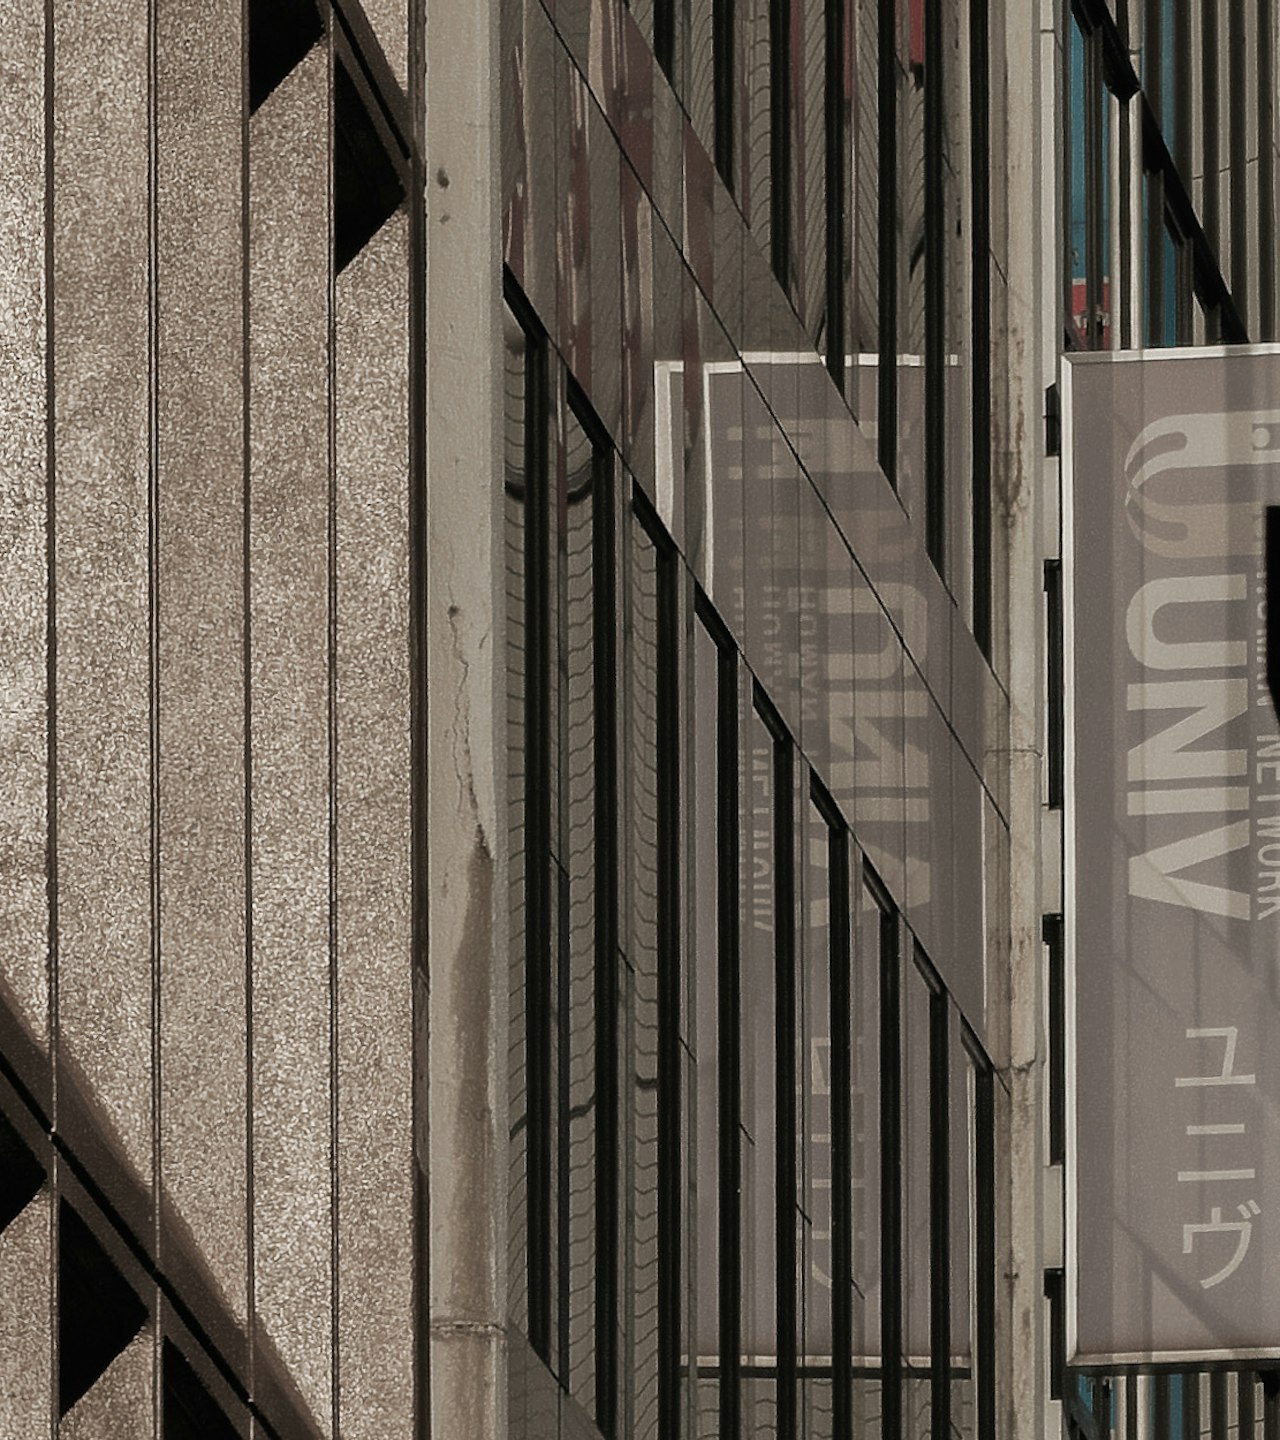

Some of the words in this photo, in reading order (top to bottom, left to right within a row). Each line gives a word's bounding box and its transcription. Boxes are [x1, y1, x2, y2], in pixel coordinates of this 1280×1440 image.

[1125, 575, 1251, 921] UNIV
[1175, 1026, 1261, 1290] ユニヴ
